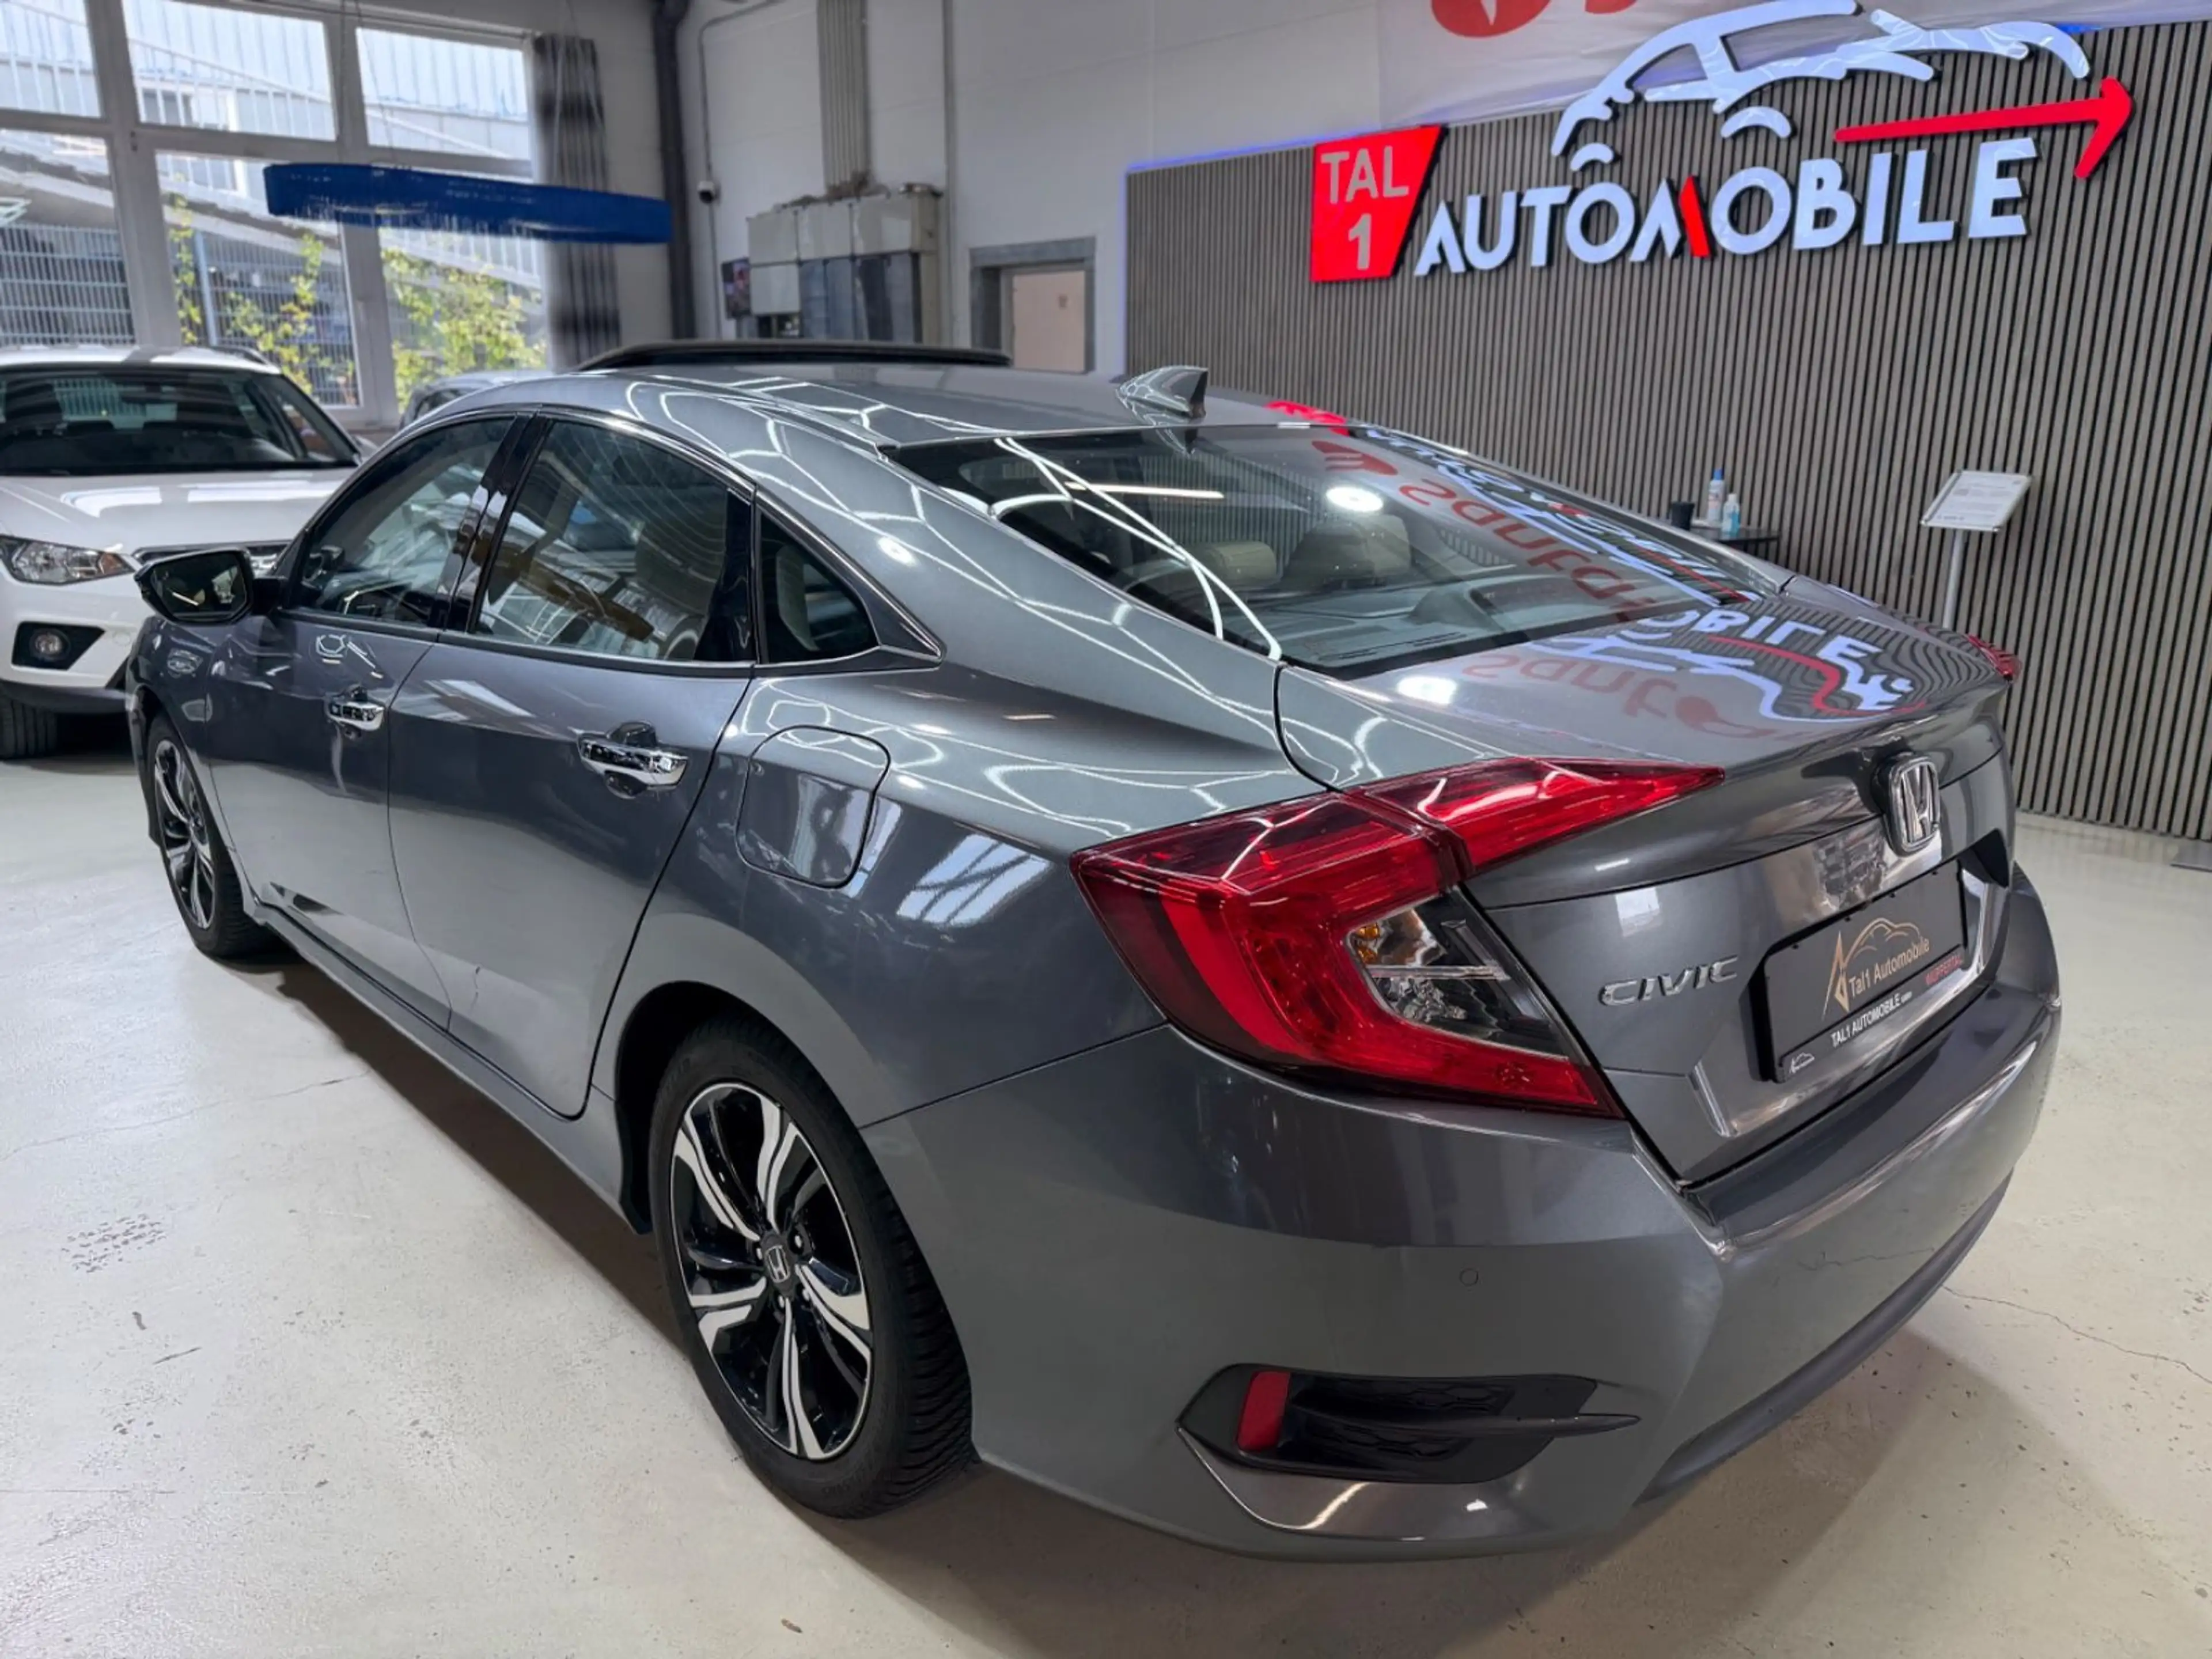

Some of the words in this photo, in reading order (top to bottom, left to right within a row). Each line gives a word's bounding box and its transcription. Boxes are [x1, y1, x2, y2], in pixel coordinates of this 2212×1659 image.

[1321, 146, 1409, 204] TAL
[1414, 137, 2037, 276] AUTOMOBILE
[1349, 213, 1372, 271] 1
[1599, 954, 1738, 1006] CIVIC
[1874, 935, 1929, 984] Automobile
[1852, 992, 1900, 1036] AUTOMOBILE
